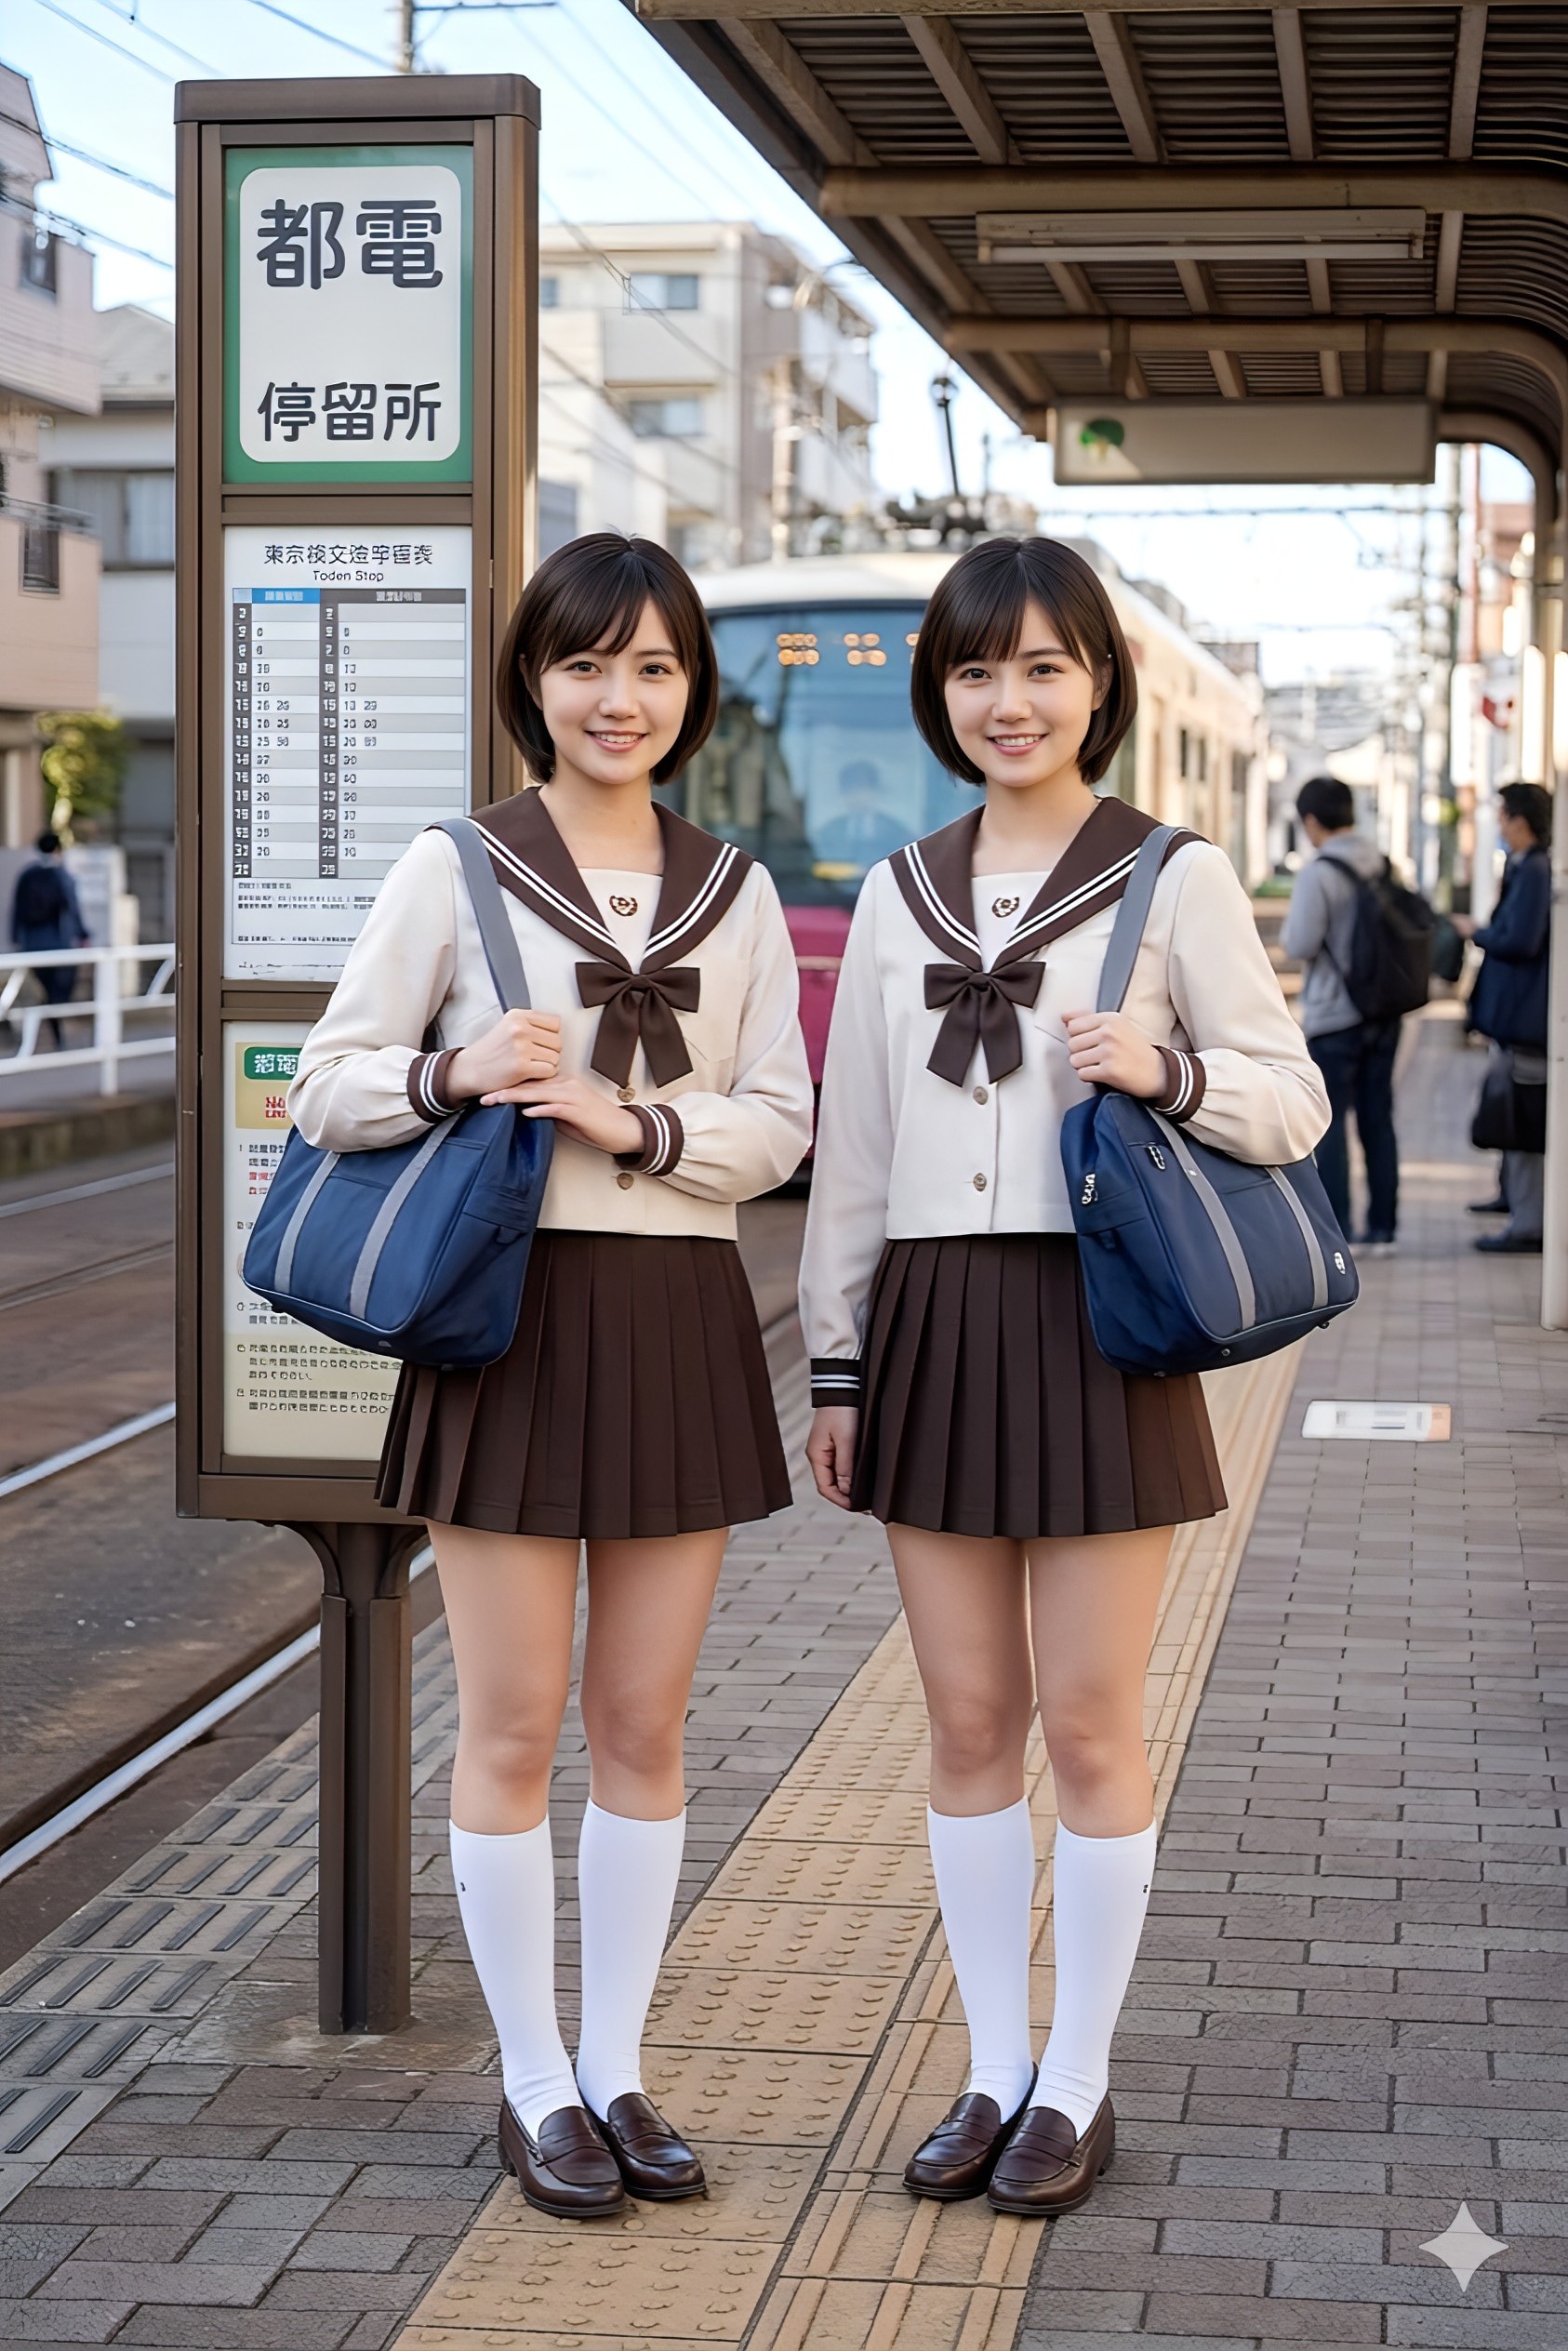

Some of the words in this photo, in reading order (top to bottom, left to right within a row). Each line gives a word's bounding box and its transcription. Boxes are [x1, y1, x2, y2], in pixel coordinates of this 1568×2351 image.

[257, 198, 444, 289] 都電
[257, 381, 442, 442] 停留所
